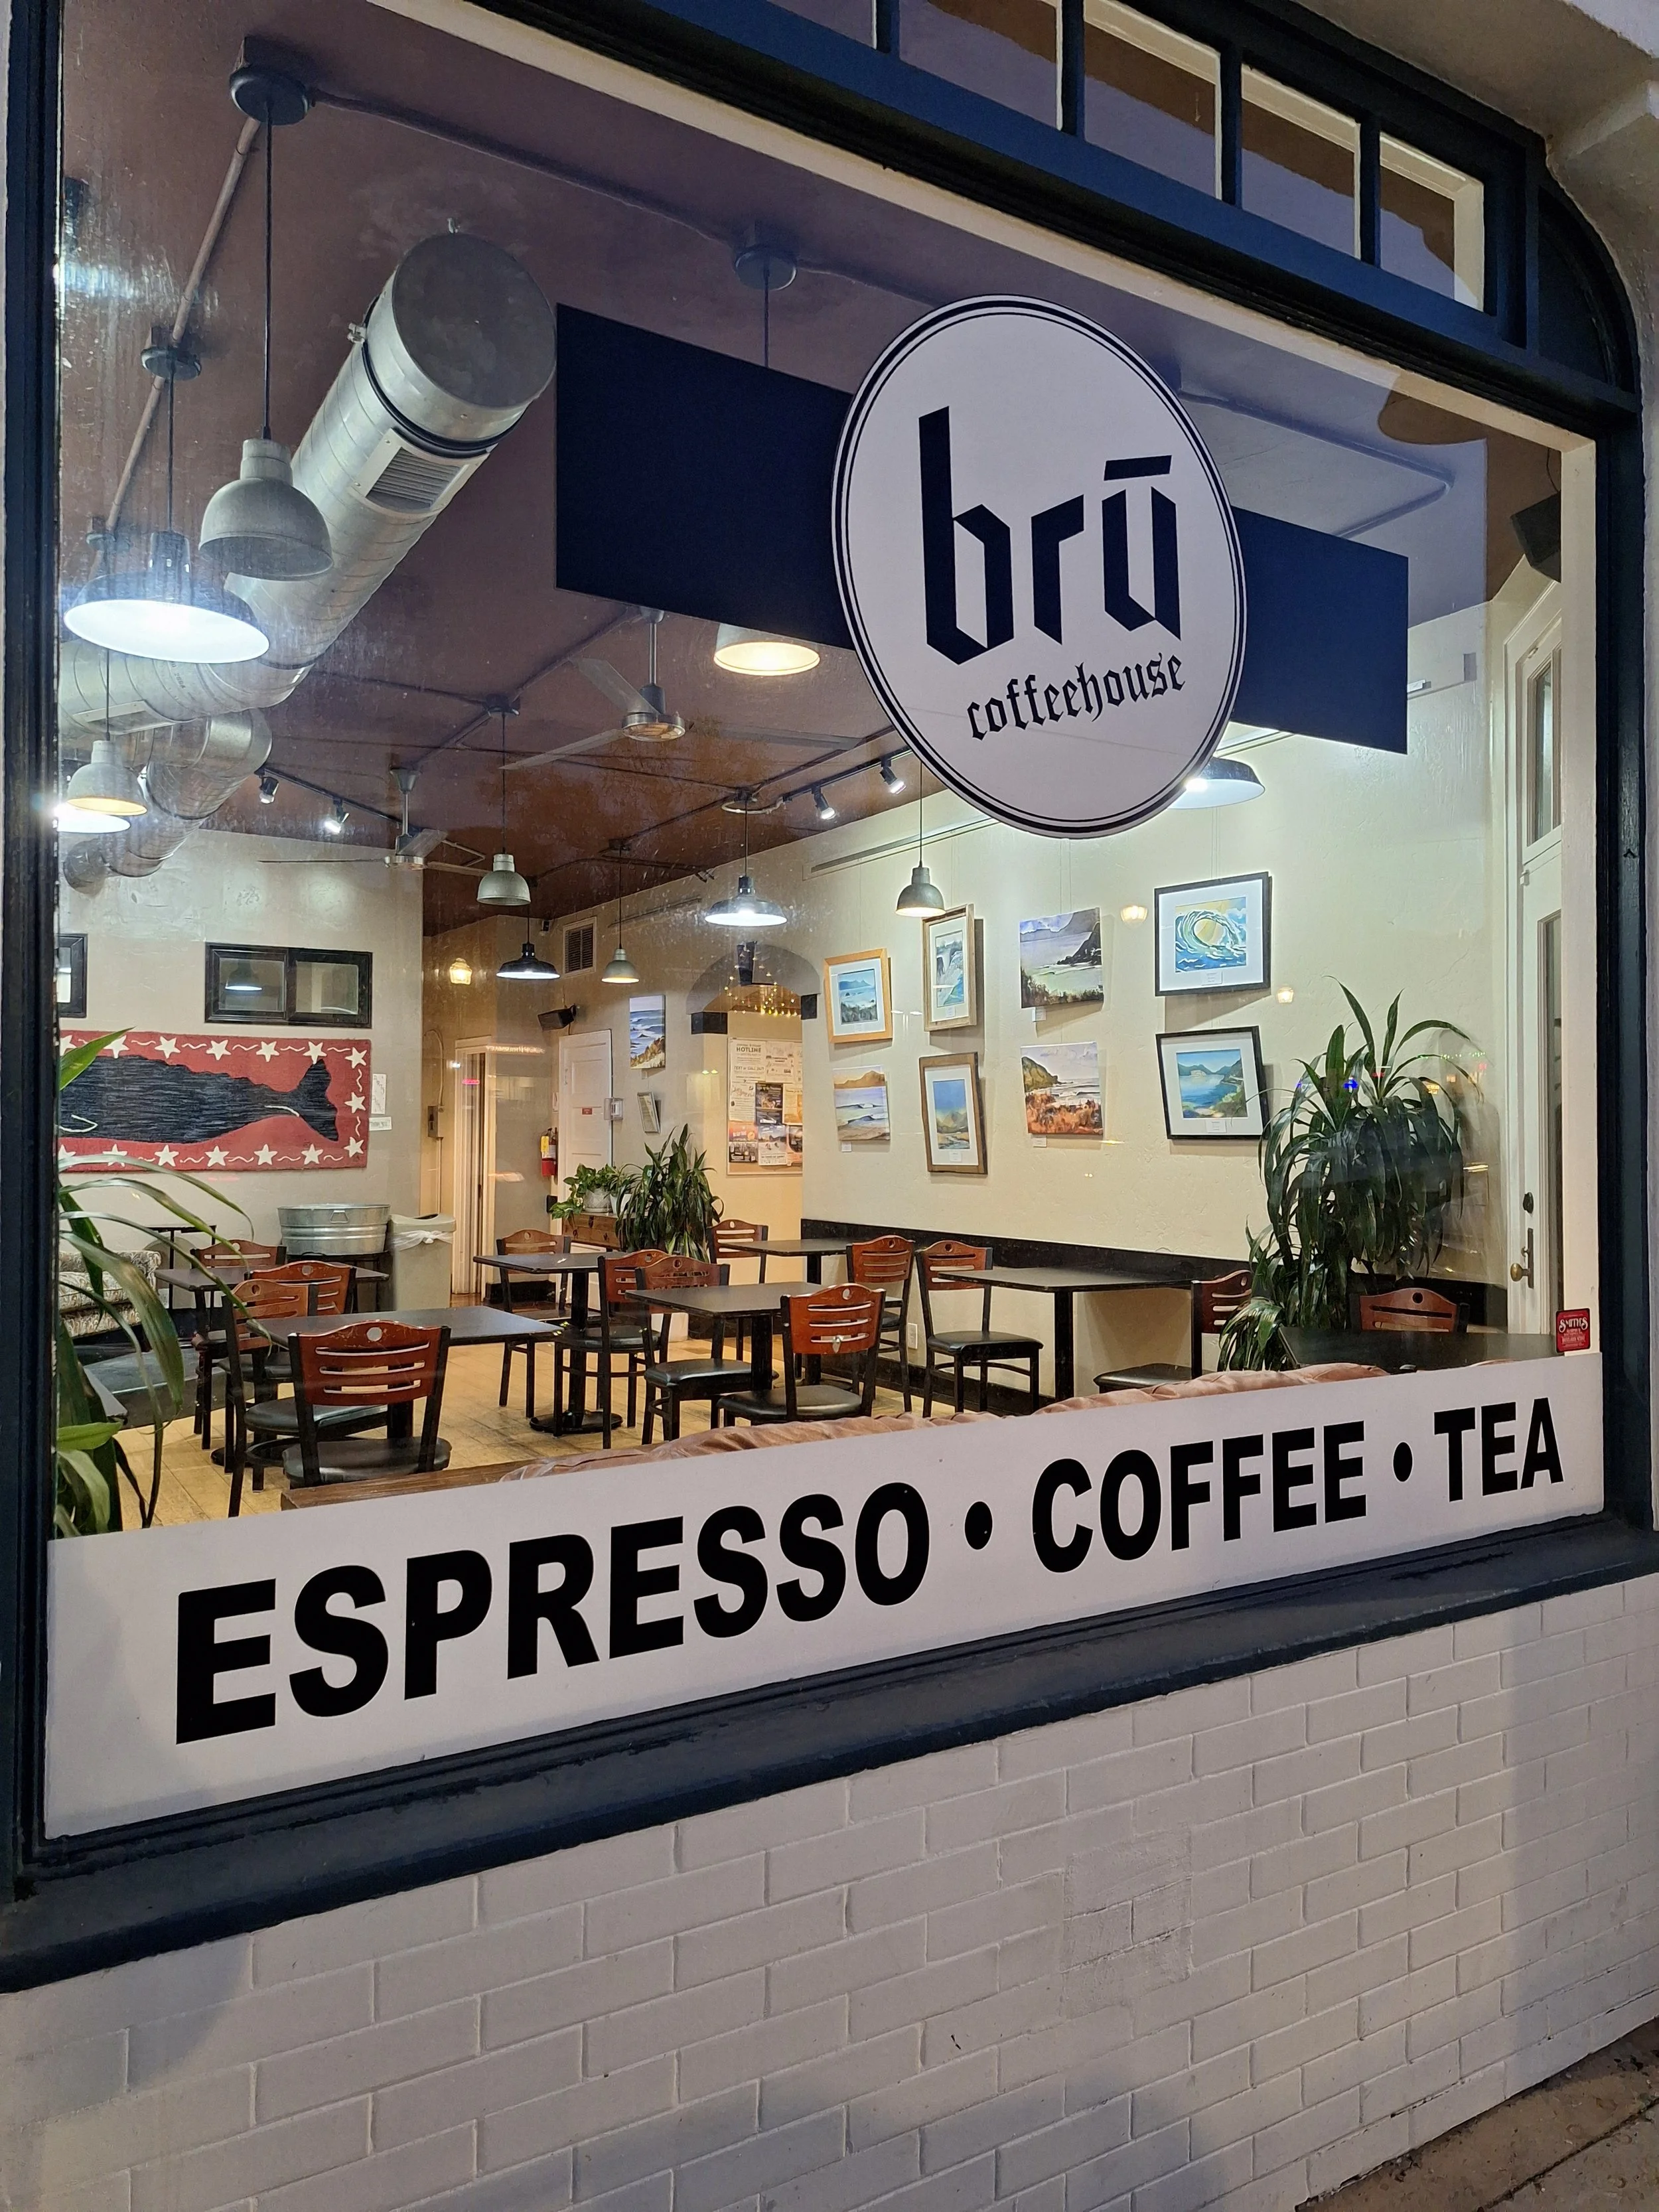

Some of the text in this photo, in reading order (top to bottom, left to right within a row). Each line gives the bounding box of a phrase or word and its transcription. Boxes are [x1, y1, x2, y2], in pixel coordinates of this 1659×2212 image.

[966, 652, 1186, 741] coffeehouse
[176, 1397, 1564, 1745] ESPRESSO COFFEE TEA
